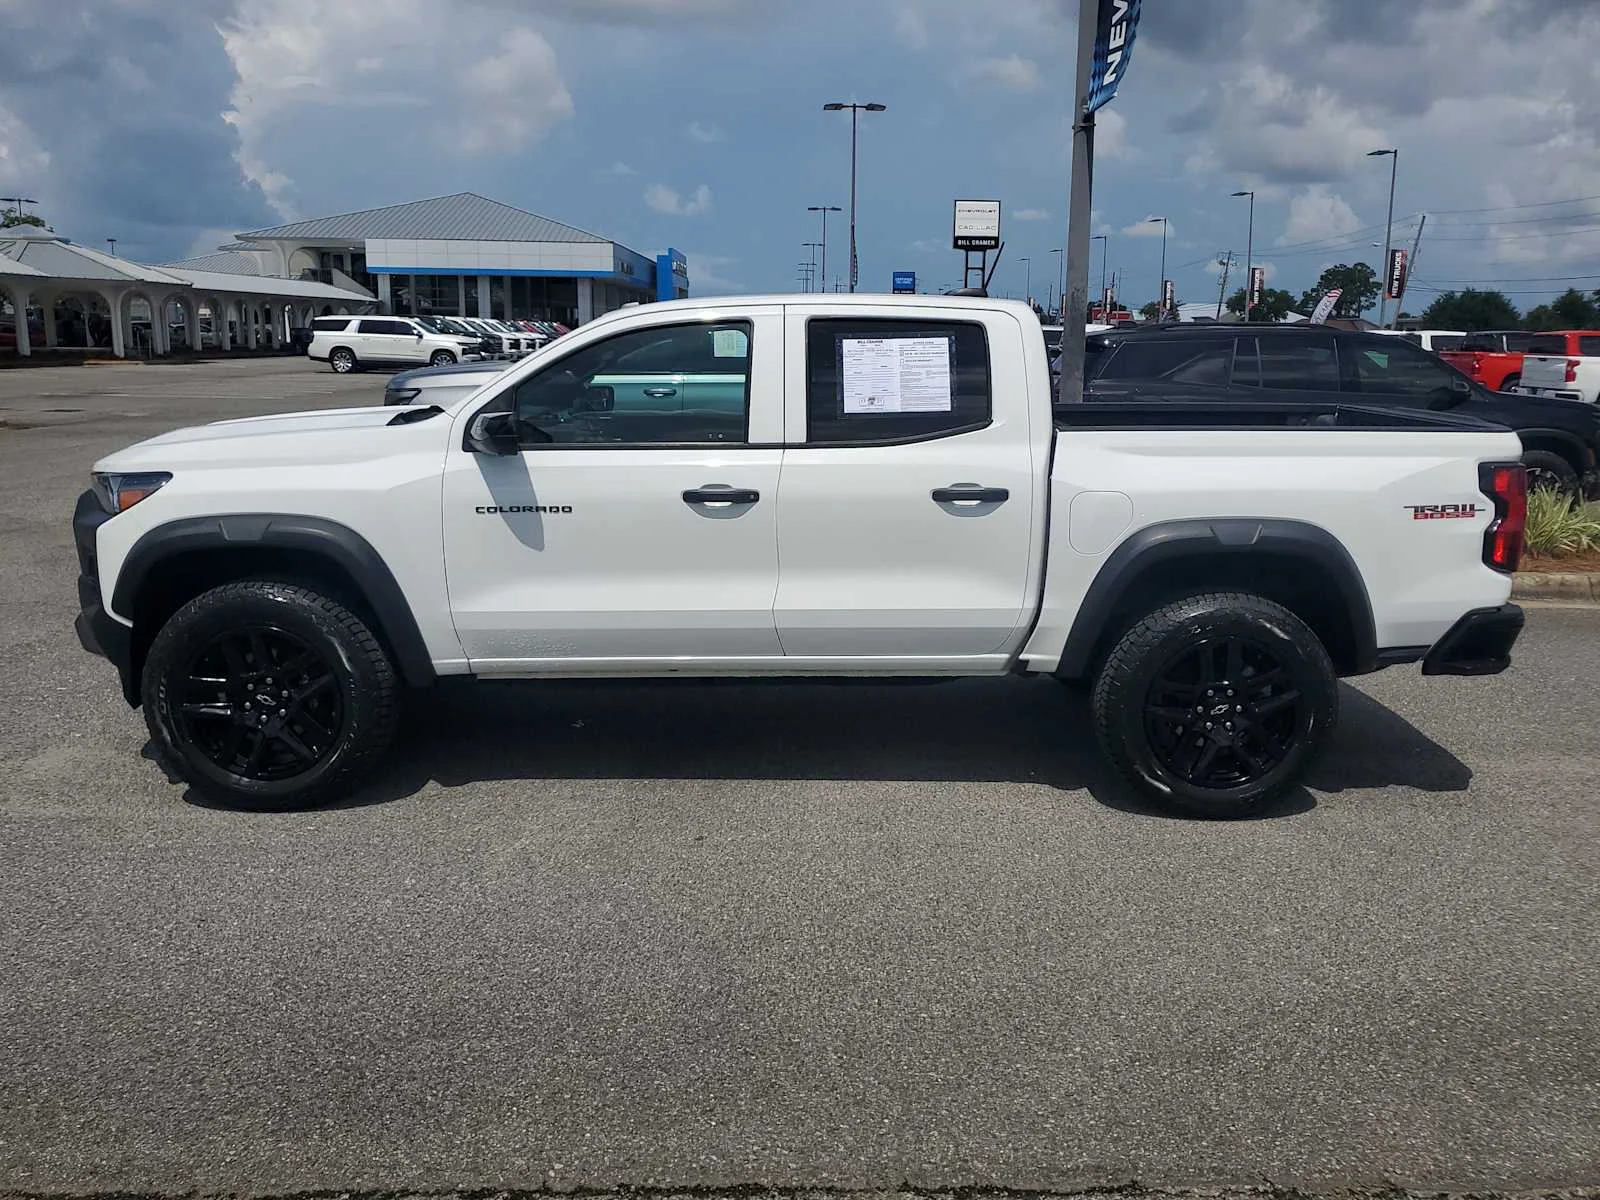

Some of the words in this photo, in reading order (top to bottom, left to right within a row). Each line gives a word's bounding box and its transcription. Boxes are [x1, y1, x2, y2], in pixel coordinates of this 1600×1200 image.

[1393, 252, 1402, 280] TRUCKS
[1391, 280, 1399, 296] NEW
[475, 505, 573, 514] COLORADO
[1403, 504, 1486, 513] TRAIL
[1413, 511, 1476, 520] BOSS
